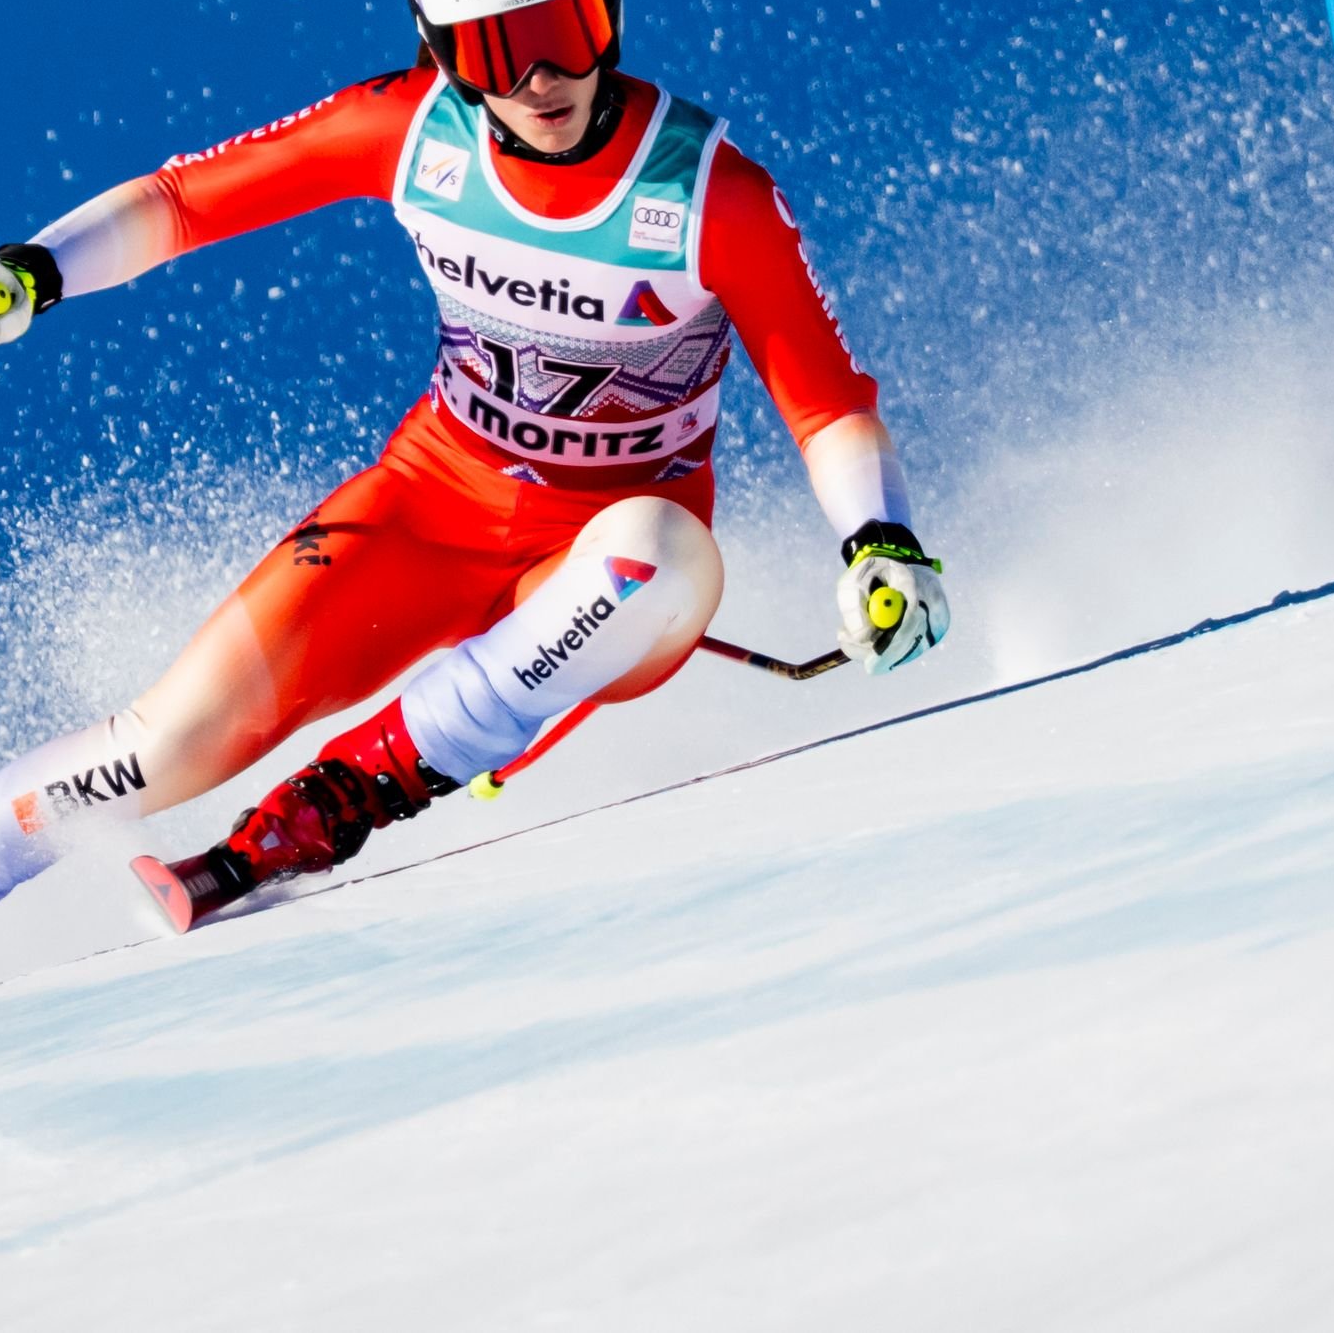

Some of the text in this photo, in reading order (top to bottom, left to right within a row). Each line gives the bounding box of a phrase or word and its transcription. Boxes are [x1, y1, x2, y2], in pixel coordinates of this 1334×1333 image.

[415, 231, 604, 322] helvetia
[476, 333, 621, 416] 17
[512, 595, 616, 691] helvetia
[44, 752, 147, 819] BKW
